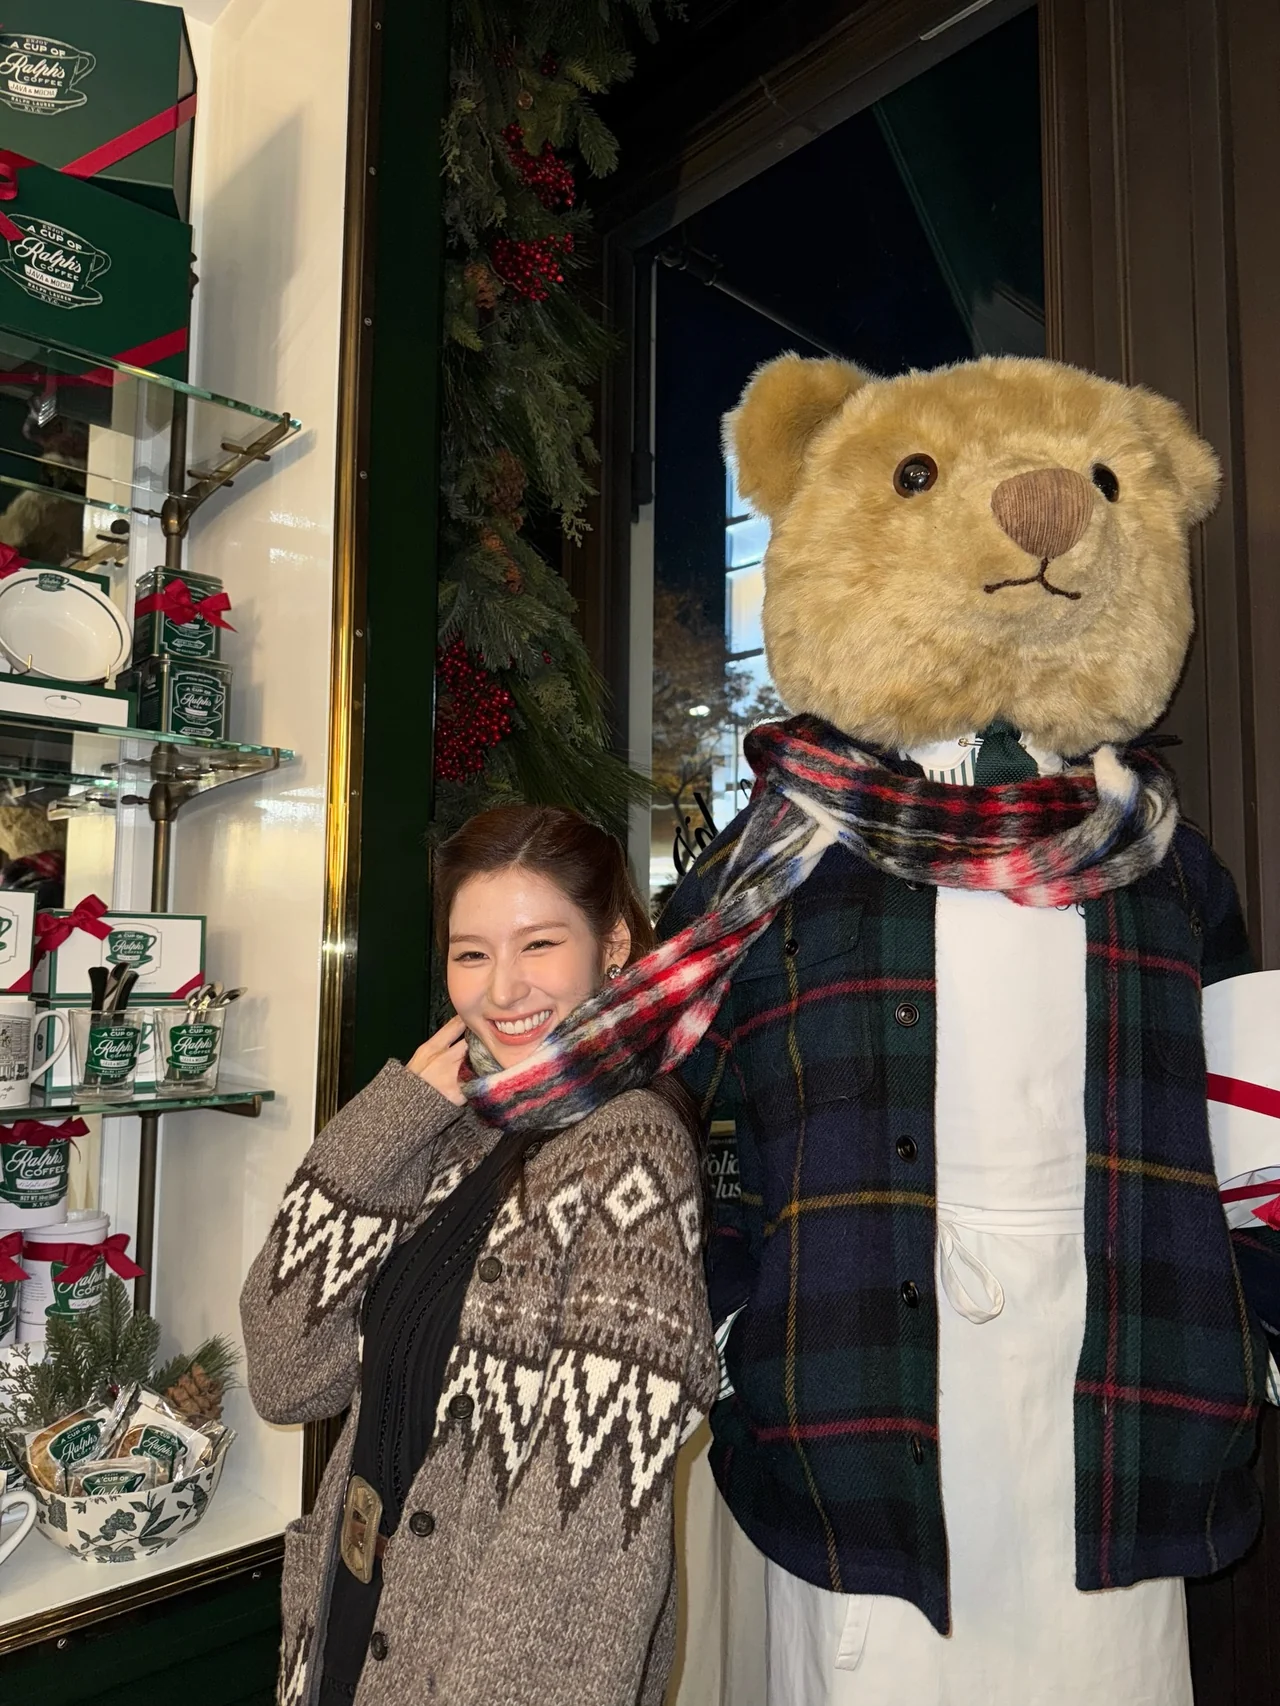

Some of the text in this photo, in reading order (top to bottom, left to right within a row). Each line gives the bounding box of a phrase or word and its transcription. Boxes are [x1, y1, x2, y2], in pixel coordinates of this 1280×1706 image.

[10, 41, 66, 57] A CUP OF
[0, 52, 65, 84] Ralph's
[11, 83, 28, 93] JAVA
[34, 89, 55, 97] MOCHA
[23, 76, 63, 87] COFFEE
[11, 96, 30, 104] RALPH
[26, 225, 82, 251] A CUP OF
[14, 237, 82, 273] Ralph's
[27, 269, 44, 282] JAVA
[51, 278, 72, 290] MOCHA
[40, 263, 80, 282] COFFEE
[27, 282, 72, 302] RALPH LAUREN
[93, 1040, 134, 1060] Ralph's
[173, 1036, 212, 1057] Ralph's
[5, 1148, 63, 1179] Ralph's
[25, 1165, 66, 1177] COFFEE
[77, 1285, 101, 1296] COFF
[67, 1429, 81, 1439] CUP
[81, 1424, 91, 1432] OF
[60, 1433, 98, 1462] Ralph's
